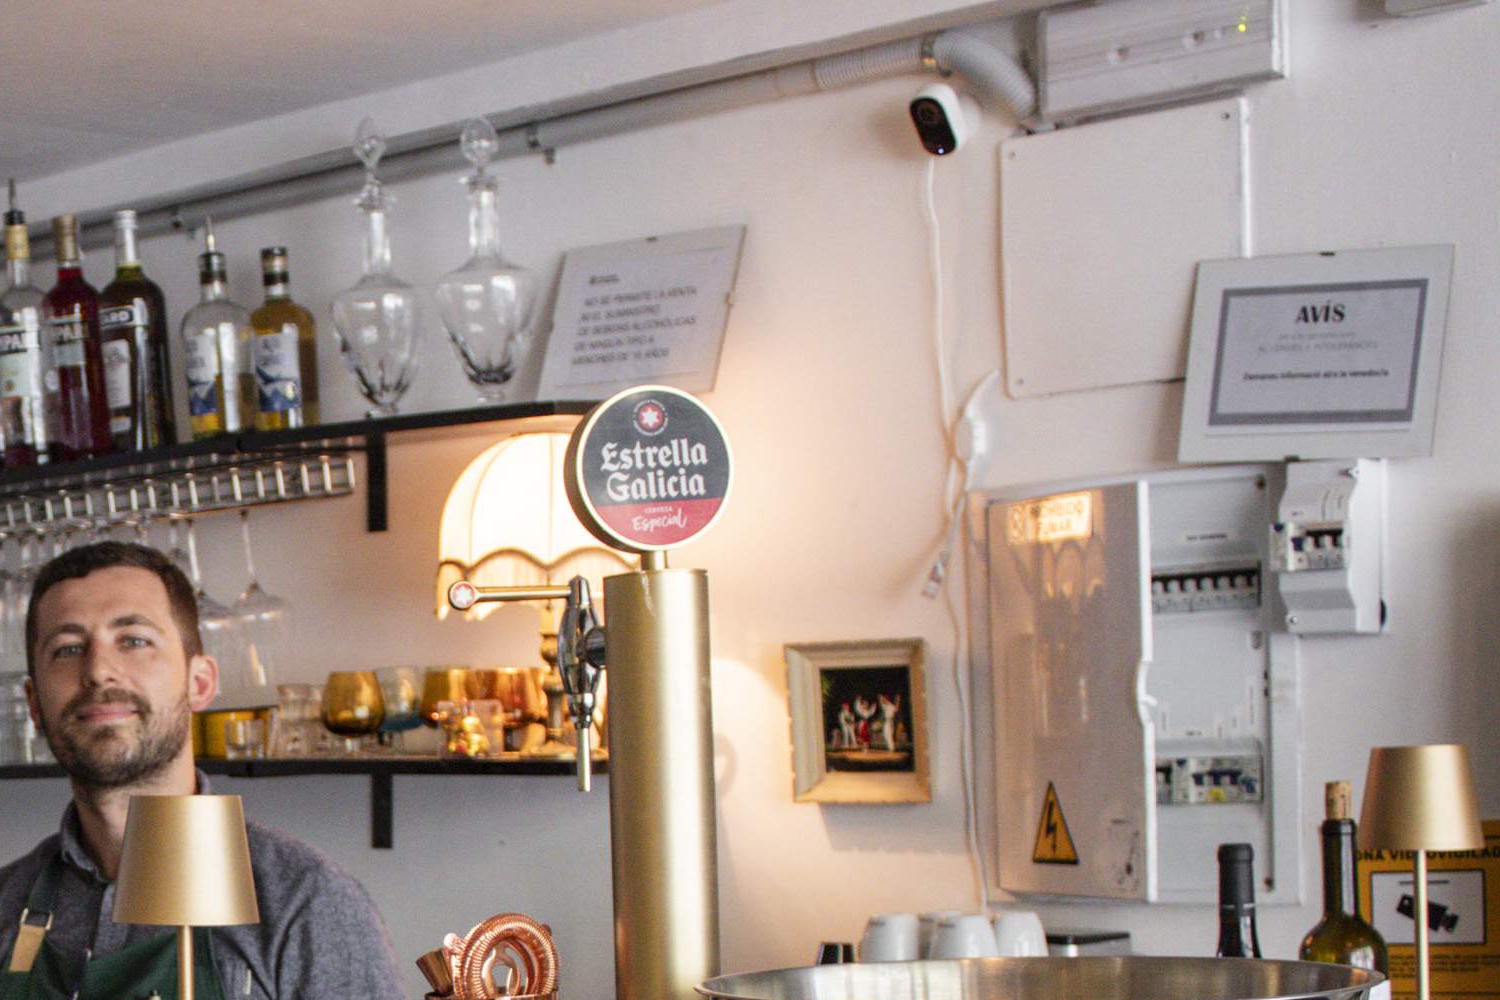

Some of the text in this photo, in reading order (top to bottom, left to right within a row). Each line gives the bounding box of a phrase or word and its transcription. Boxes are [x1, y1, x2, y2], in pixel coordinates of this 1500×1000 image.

[600, 437, 708, 472] Estrella
[606, 468, 707, 502] Galicia
[632, 508, 688, 533] Especial
